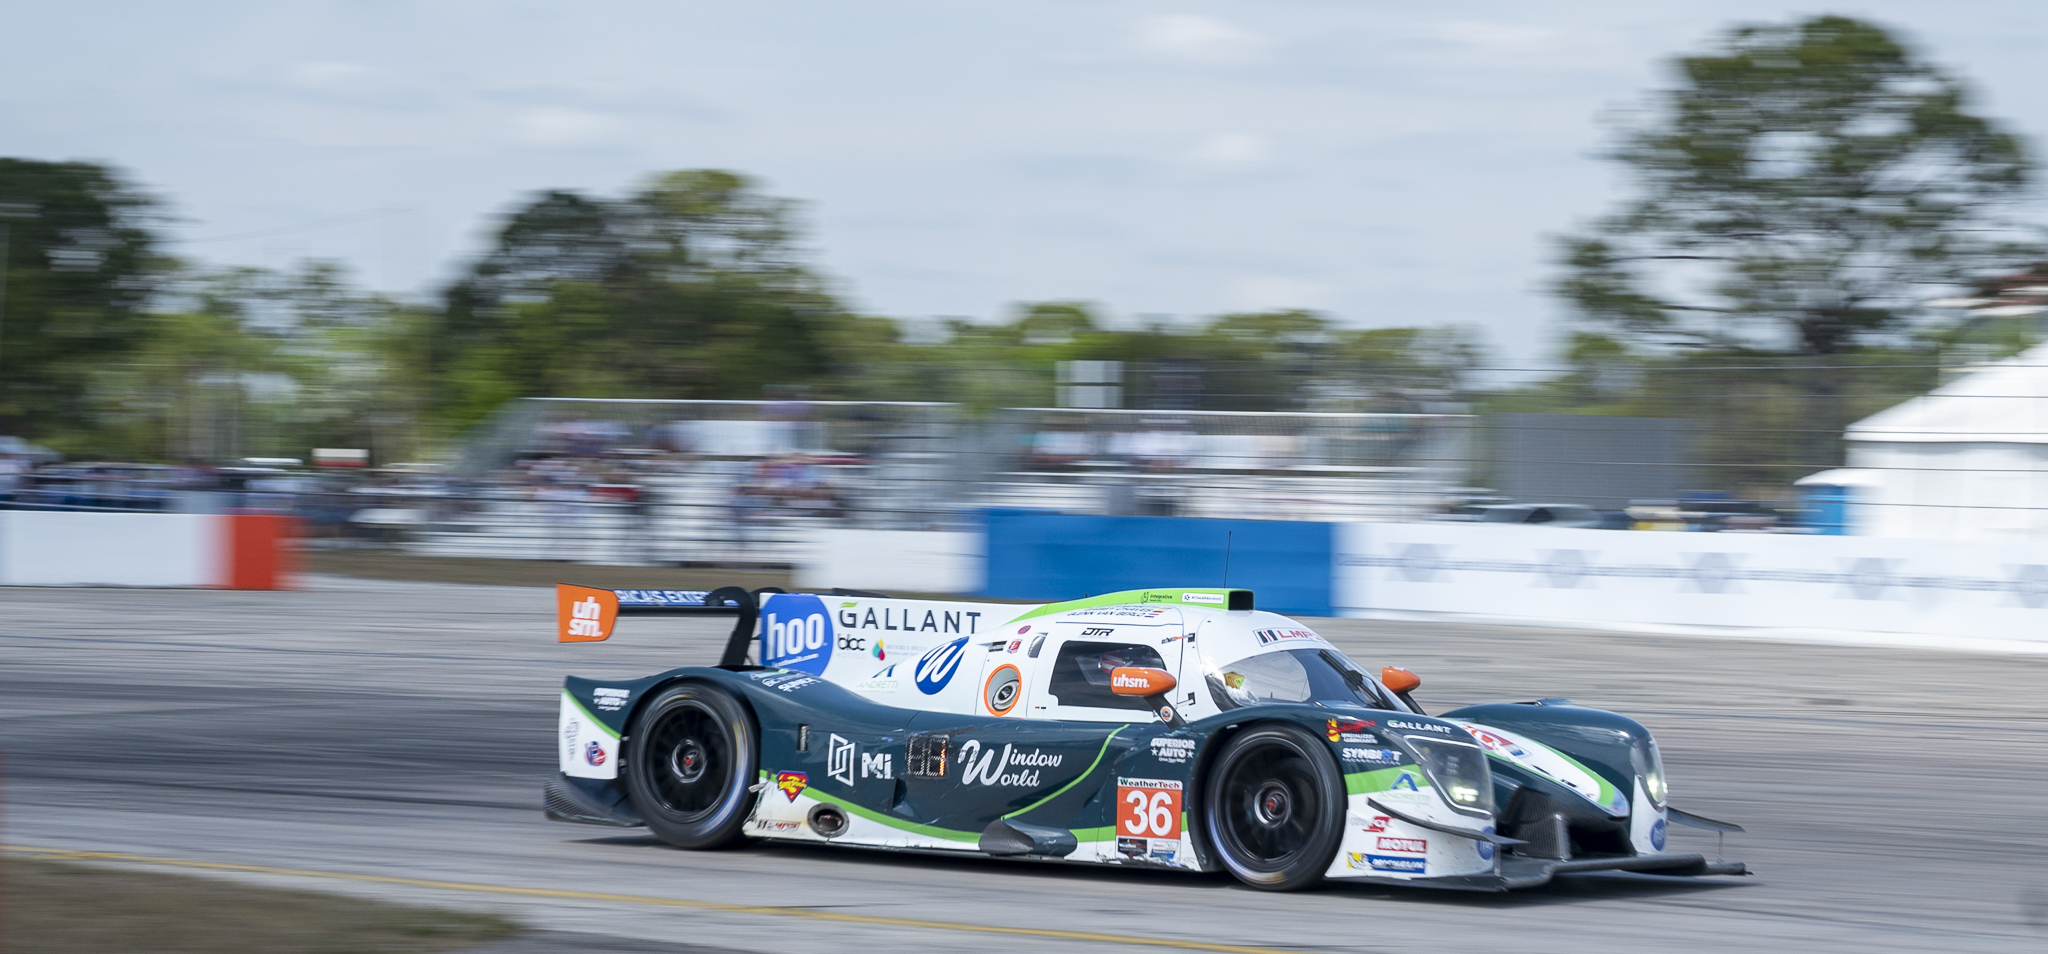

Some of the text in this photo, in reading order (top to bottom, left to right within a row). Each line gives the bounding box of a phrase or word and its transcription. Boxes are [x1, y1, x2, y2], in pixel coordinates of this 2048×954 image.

[572, 596, 601, 620] uh
[567, 618, 604, 637] sm.
[839, 606, 981, 634] GALLANT
[766, 612, 825, 661] hoo
[1112, 673, 1151, 688] uhsm.
[1387, 719, 1452, 734] GALLANT
[1150, 737, 1196, 750] SUPERIOR
[1158, 747, 1187, 758] AUTO
[958, 739, 1062, 786] Window
[1120, 778, 1180, 789] WeatherTech
[1124, 789, 1173, 836] 36
[1380, 837, 1426, 852] MOTUL
